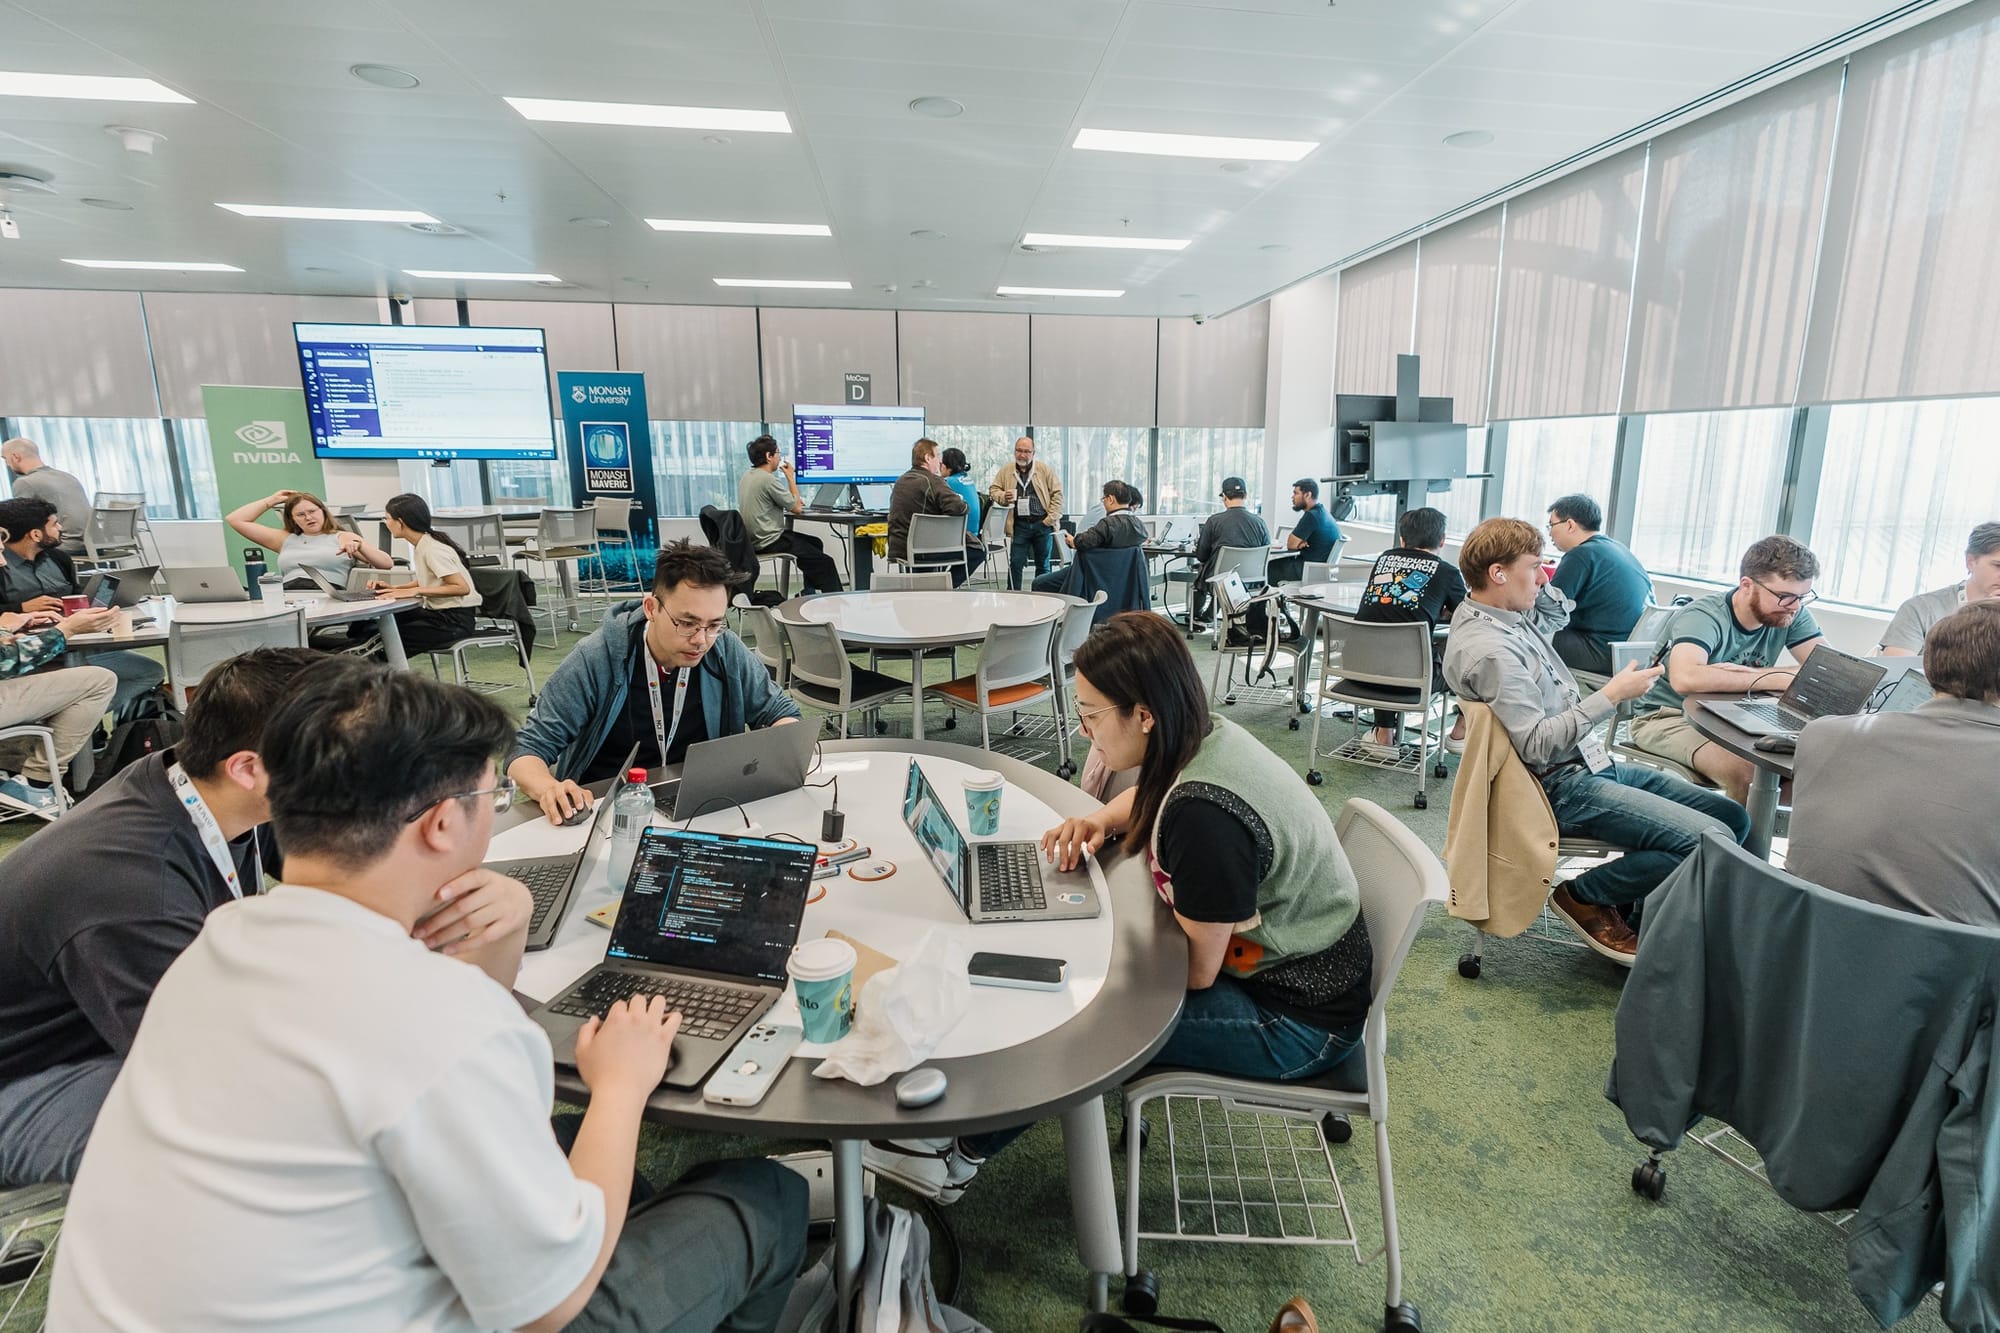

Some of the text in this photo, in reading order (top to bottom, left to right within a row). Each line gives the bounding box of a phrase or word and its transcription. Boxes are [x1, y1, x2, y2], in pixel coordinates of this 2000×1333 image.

[588, 385, 632, 396] MONASH
[852, 384, 865, 400] D
[588, 394, 629, 406] University
[233, 452, 302, 464] NVIDIA
[590, 470, 627, 480] MONASH
[591, 479, 628, 488] MAVERIC
[1387, 555, 1440, 567] GRADUATE
[1381, 566, 1401, 574] DAY
[1384, 560, 1438, 575] RESEARCH
